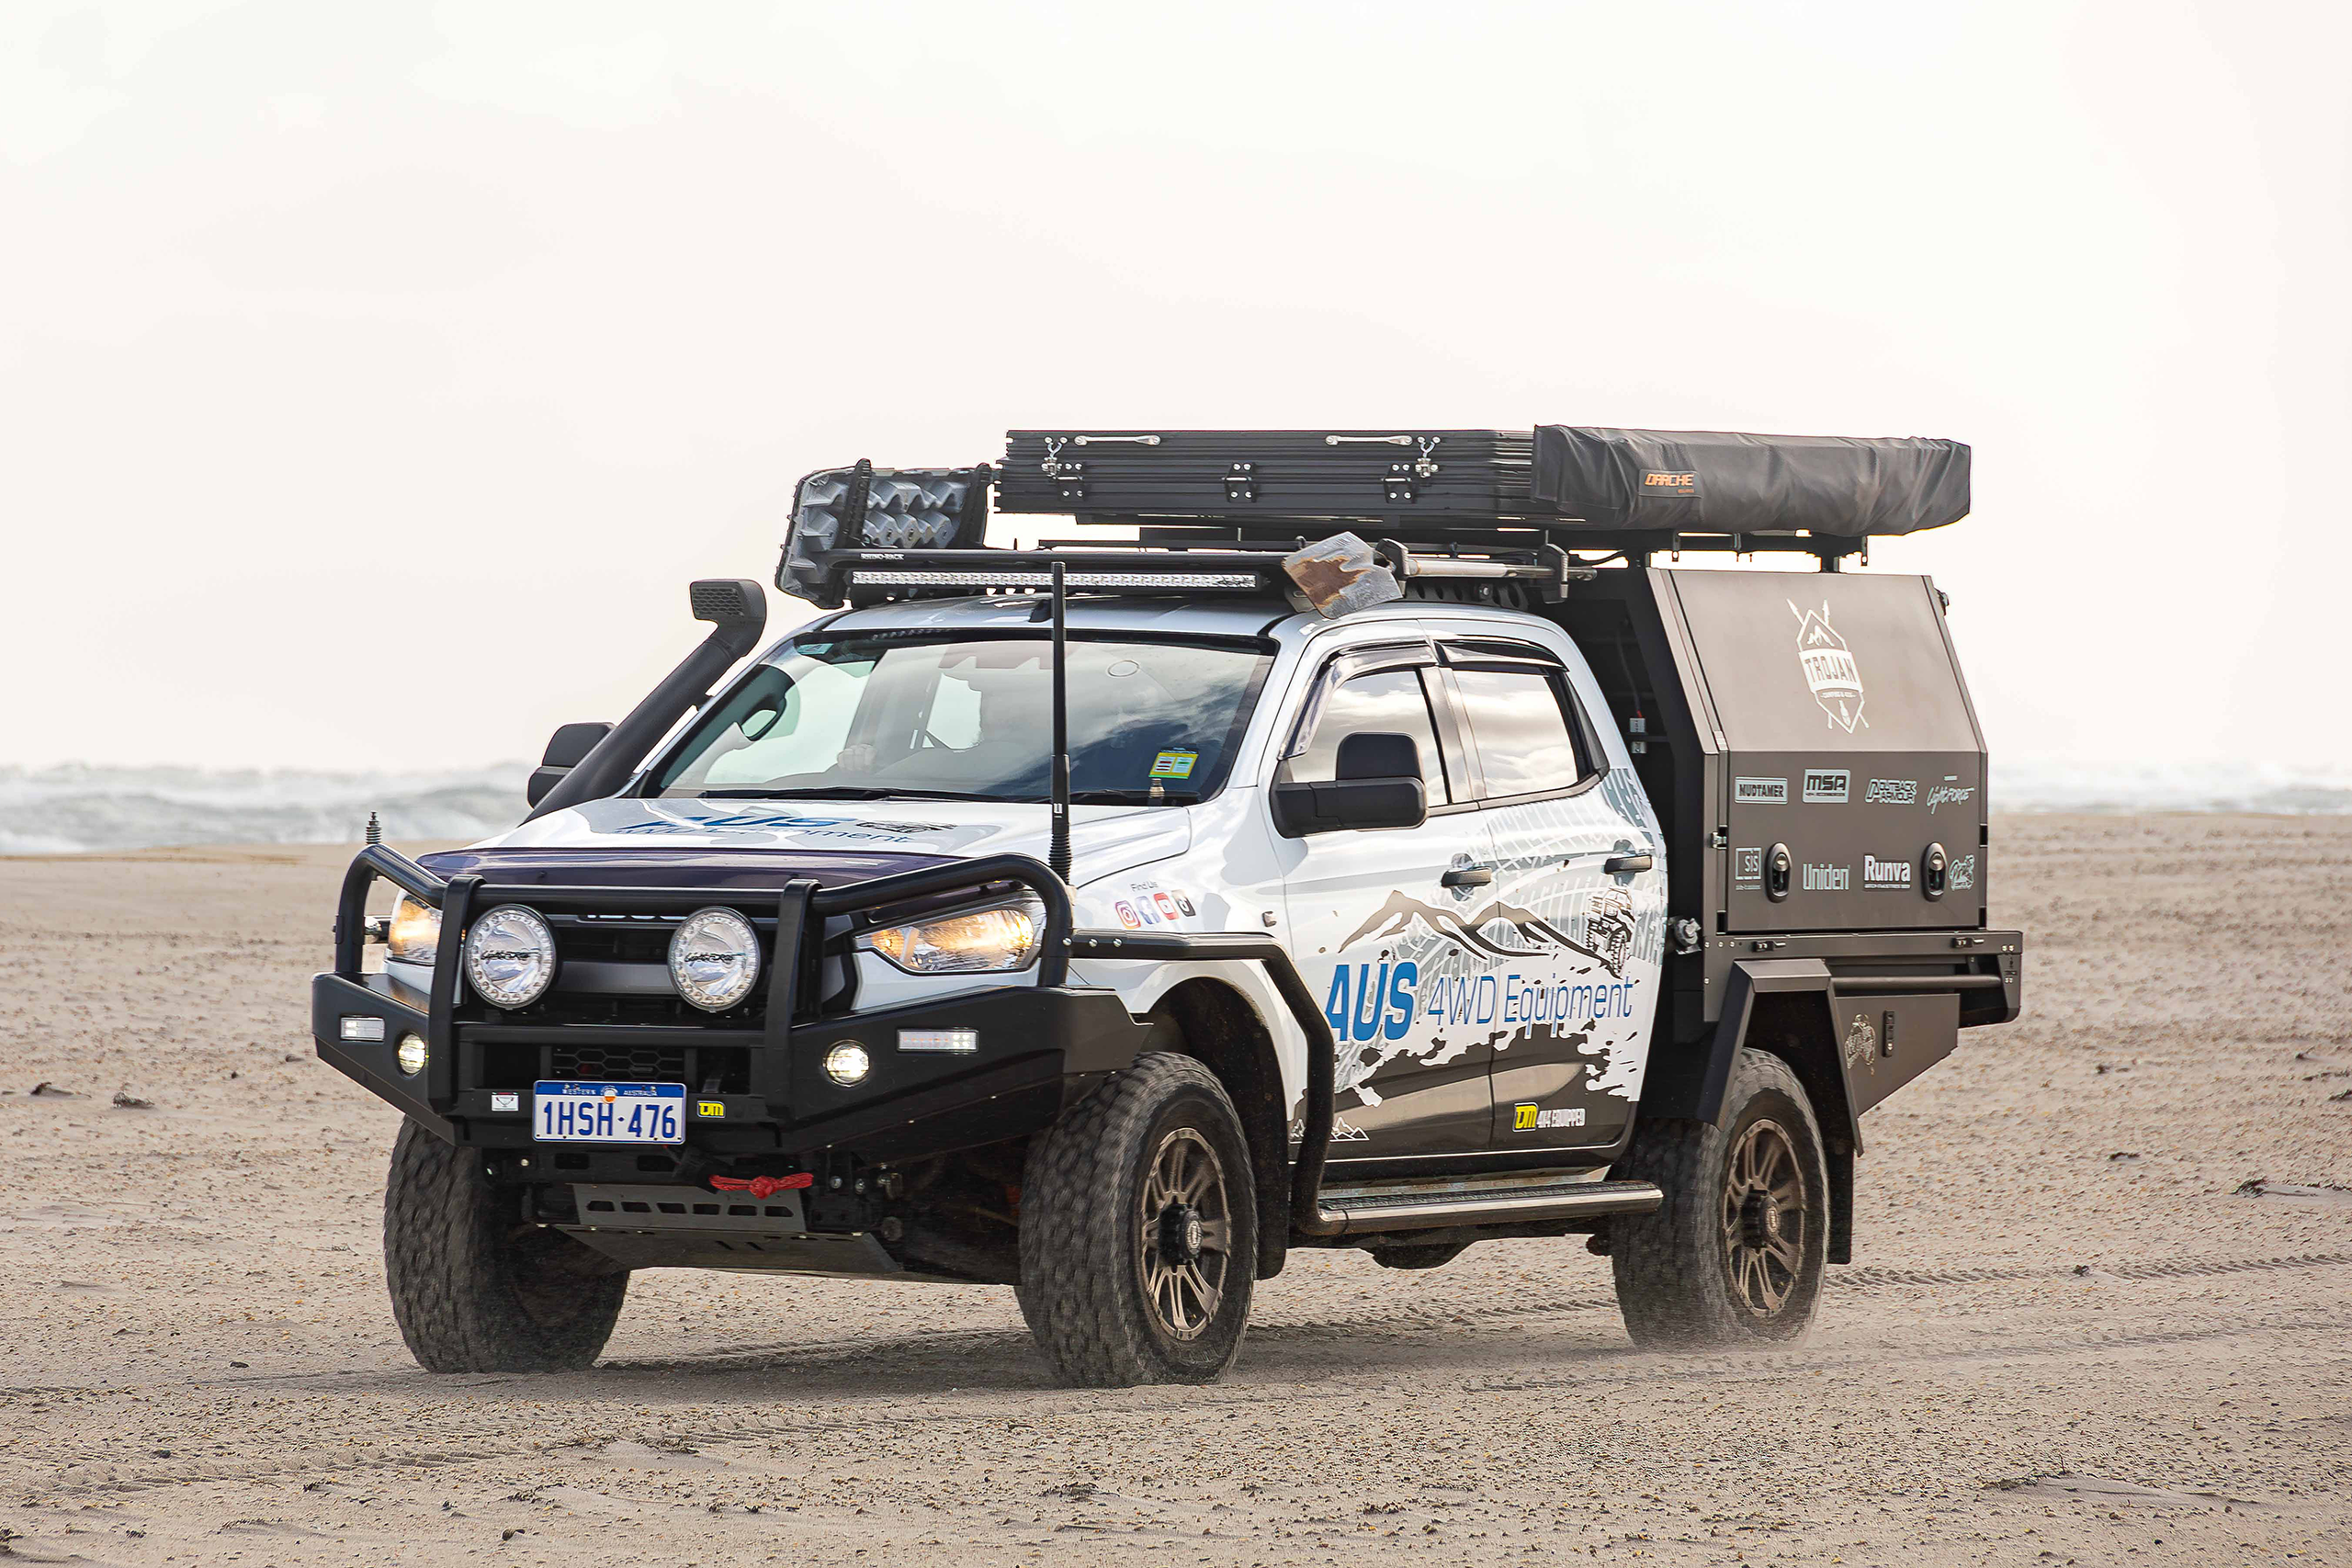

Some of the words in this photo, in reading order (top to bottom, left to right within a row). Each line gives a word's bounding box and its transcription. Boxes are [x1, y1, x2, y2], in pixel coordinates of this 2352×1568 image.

[1645, 473, 1694, 486] DARCHE
[1804, 656, 1857, 682] TROJAN
[1738, 784, 1784, 797] MUDTAMER
[1806, 774, 1847, 791] MSA
[1803, 863, 1850, 890] Uniden
[1864, 855, 1911, 882] Runva
[1325, 962, 1418, 1041] AUS
[1428, 976, 1497, 1026] 4WD
[1504, 973, 1634, 1036] Equipment
